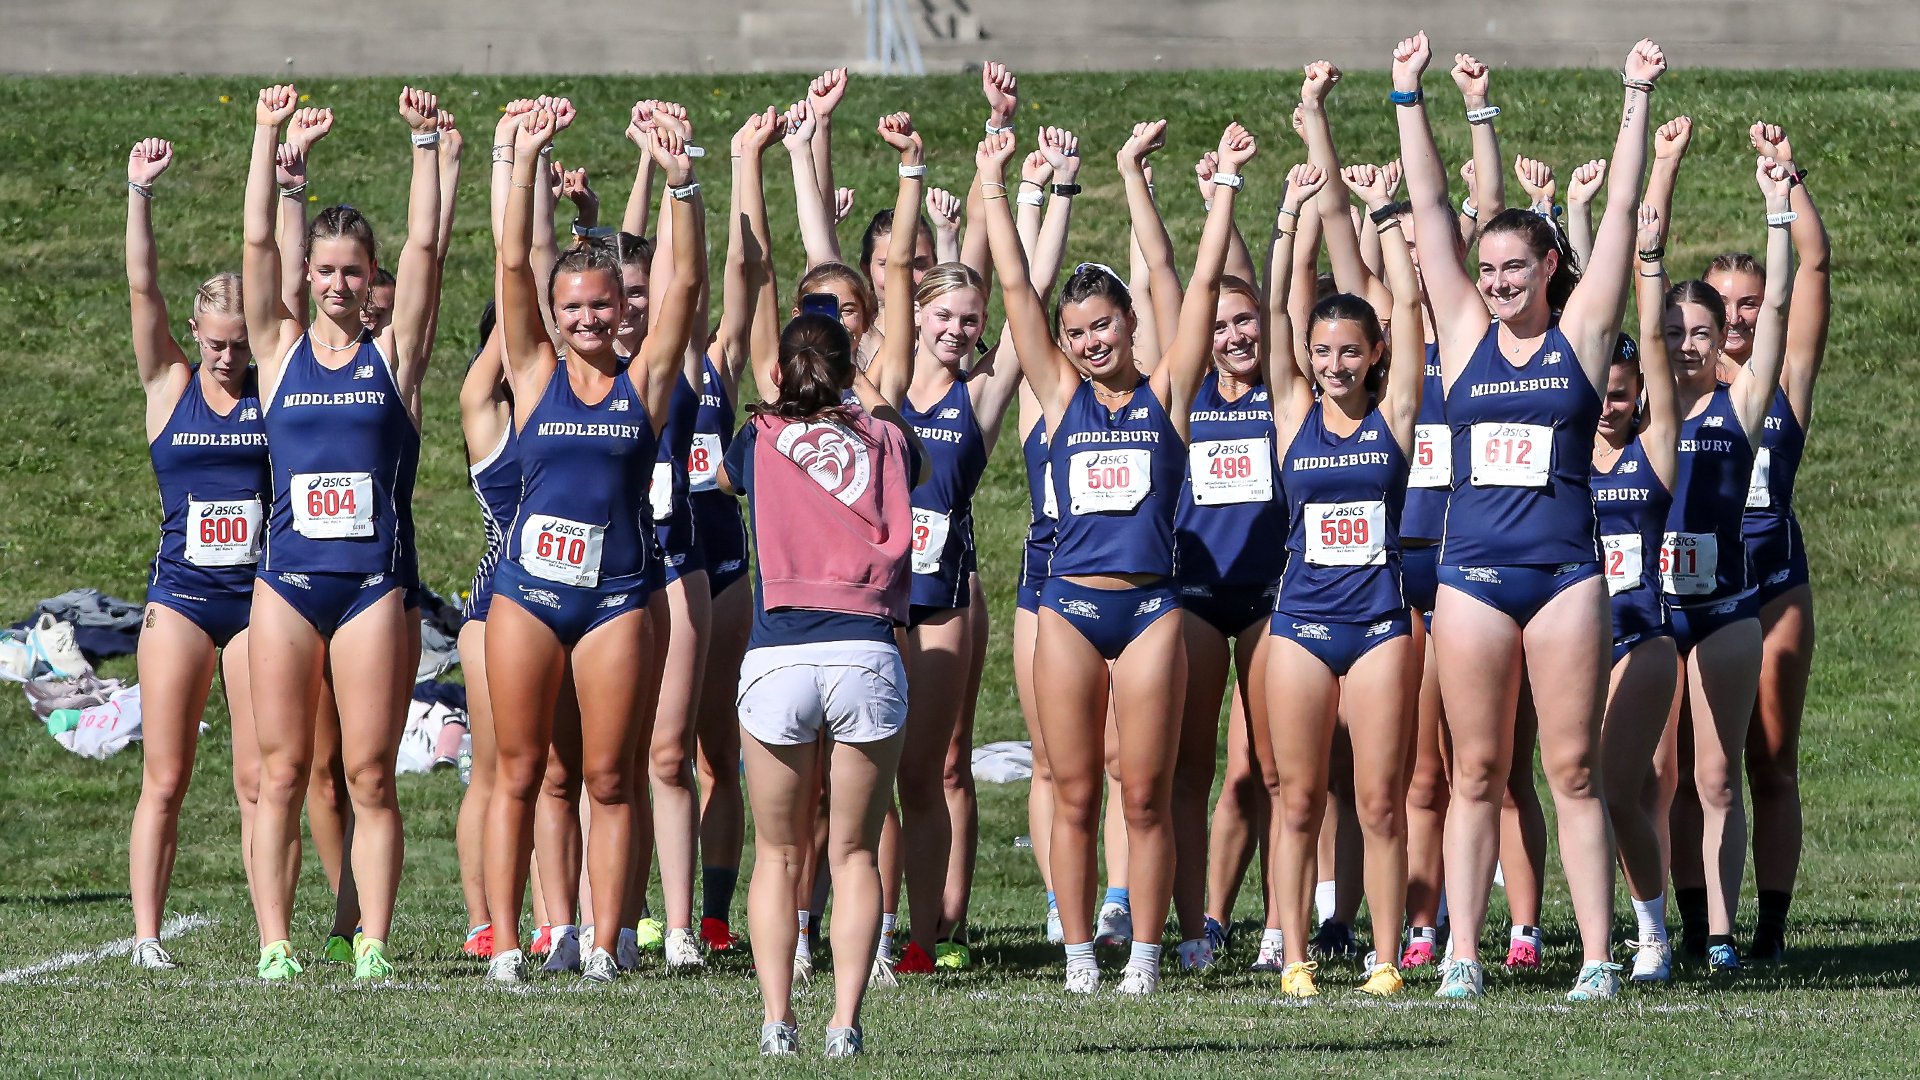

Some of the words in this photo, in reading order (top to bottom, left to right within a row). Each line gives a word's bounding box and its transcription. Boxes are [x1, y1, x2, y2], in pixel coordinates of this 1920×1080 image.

[1470, 377, 1569, 398] MIDDLEBURY
[283, 391, 386, 409] MIDDLEBURY
[1189, 410, 1274, 422] MIDDLEBURY
[171, 433, 269, 447] MIDDLEBURY
[537, 422, 640, 439] MIDDLEBURY
[1067, 430, 1160, 448] MIDDLEBURY
[1418, 441, 1433, 466] 5
[1485, 438, 1533, 465] 612
[1678, 439, 1733, 453] EBURY
[1210, 455, 1252, 479] 499
[1293, 451, 1389, 472] MIDDLEBURY
[1087, 466, 1130, 490] 500
[307, 489, 357, 517] 604
[1594, 488, 1650, 501] EBURY
[200, 517, 248, 544] 600
[1320, 518, 1369, 546] 599
[537, 532, 586, 565] 610
[1659, 547, 1698, 574] 611
[523, 594, 562, 610] MIDDLEBURY
[1063, 607, 1100, 620] MIDDLEBURY
